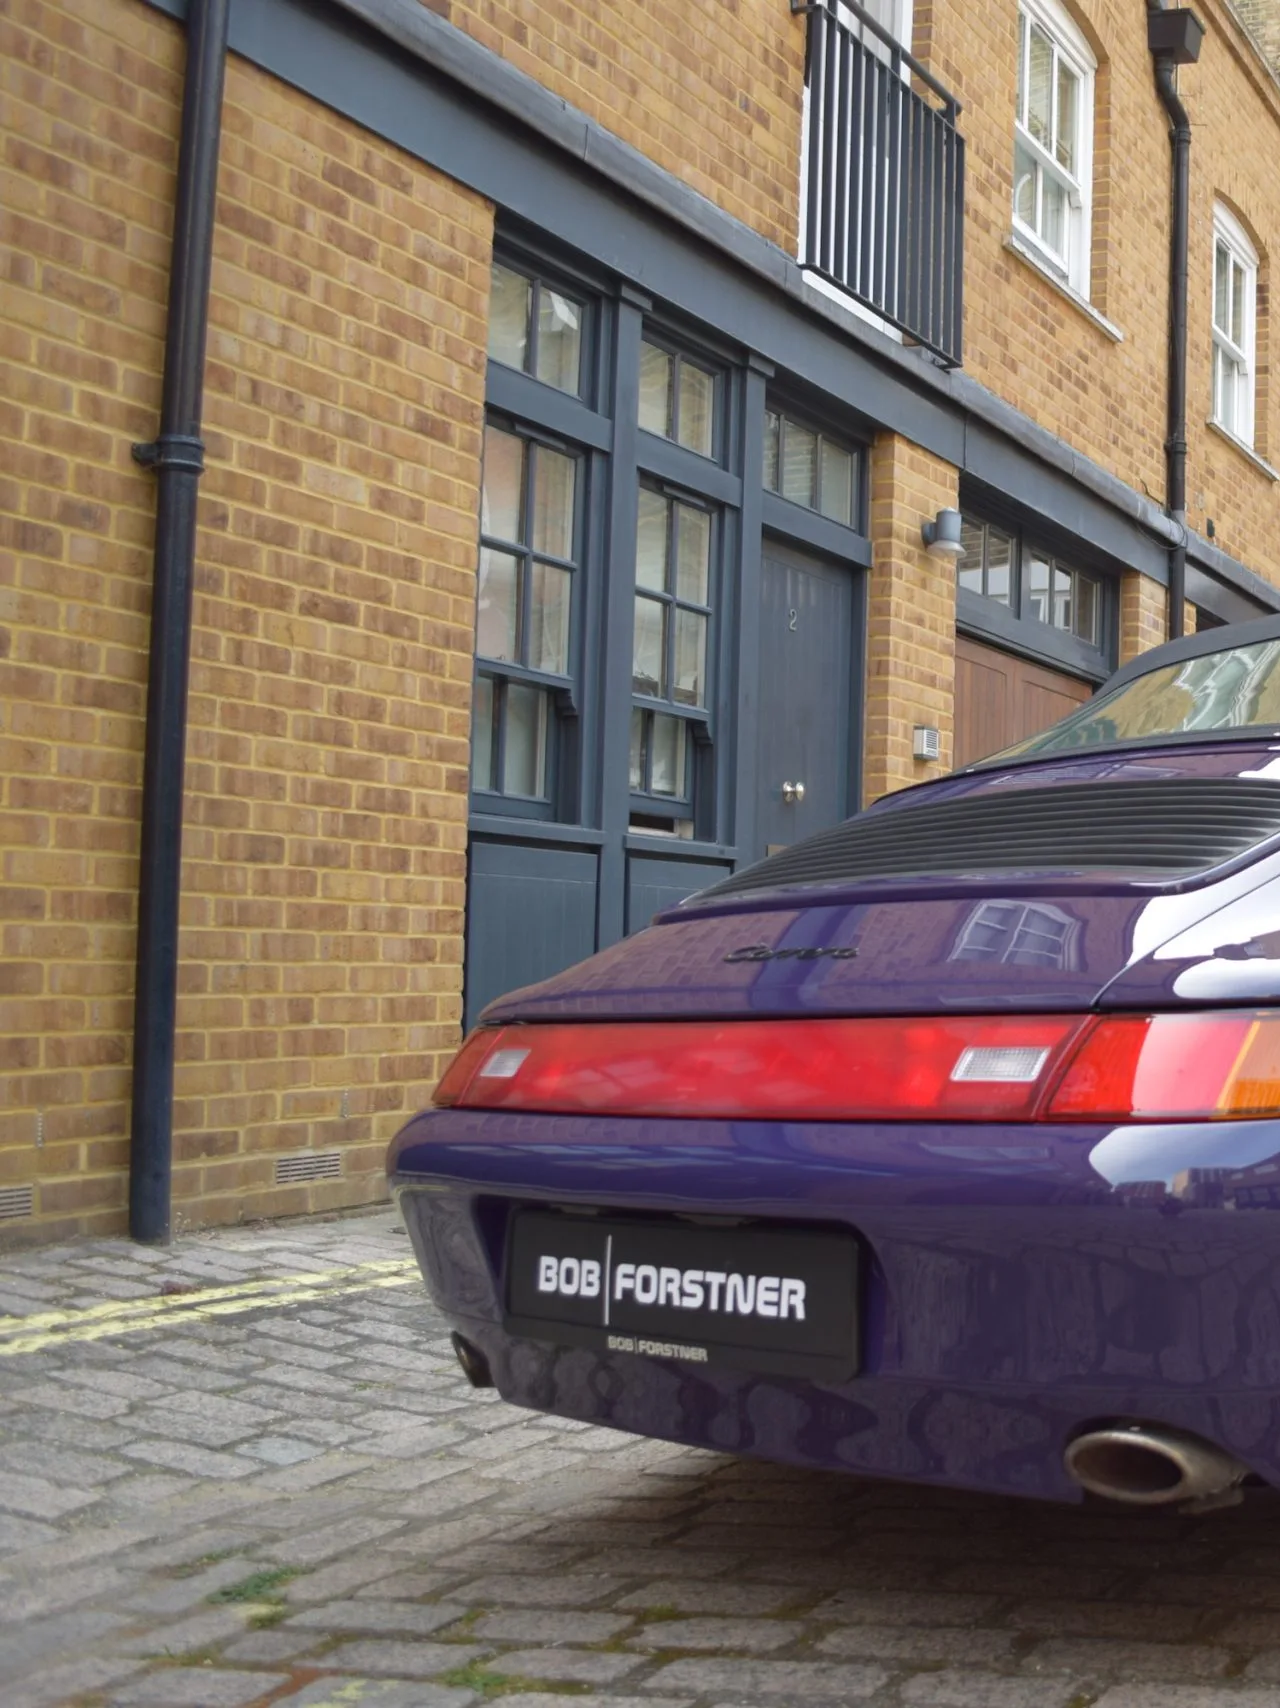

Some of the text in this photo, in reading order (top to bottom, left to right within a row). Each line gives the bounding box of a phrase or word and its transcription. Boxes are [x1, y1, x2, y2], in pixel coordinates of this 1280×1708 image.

[788, 608, 797, 632] 2
[538, 1255, 807, 1320] BOB FORSTNER
[608, 1335, 708, 1362] BOB FORSTNER
